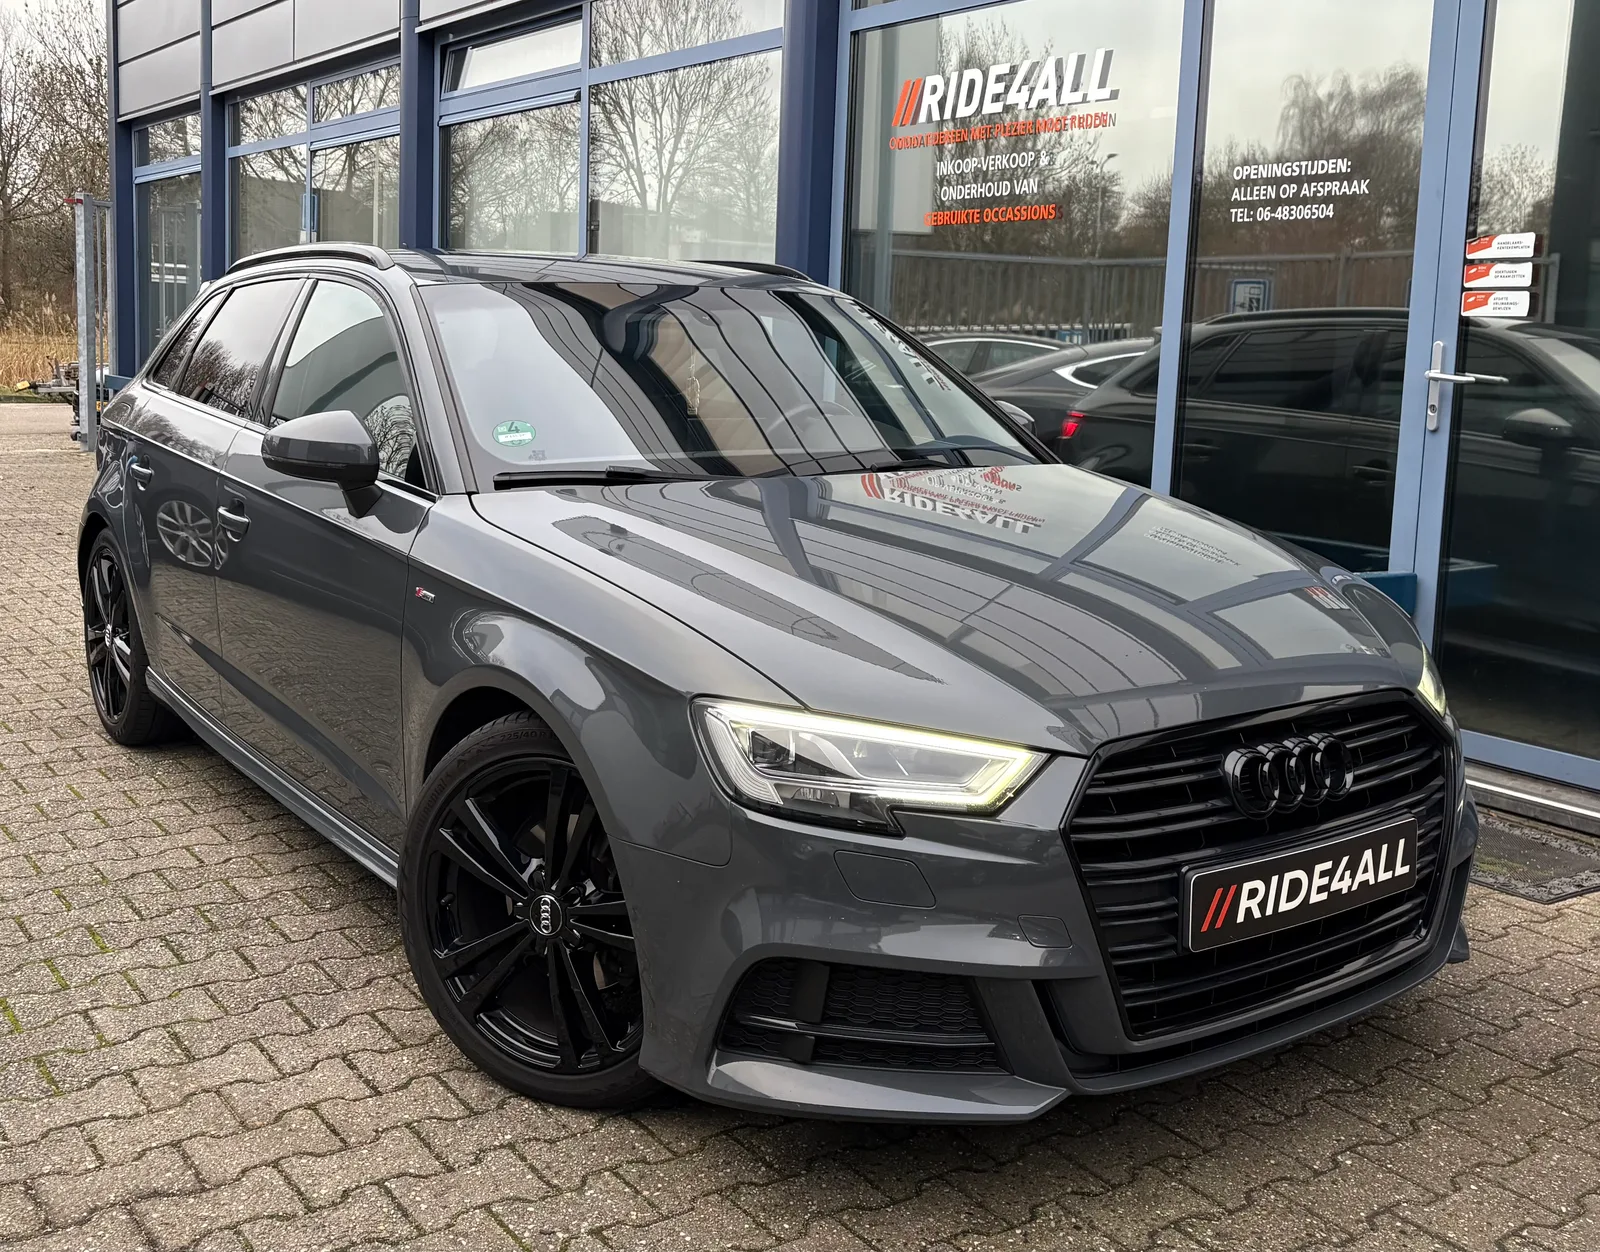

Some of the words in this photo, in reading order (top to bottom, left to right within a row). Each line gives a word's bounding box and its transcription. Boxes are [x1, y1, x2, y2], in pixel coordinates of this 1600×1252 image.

[970, 125, 993, 141] MET
[994, 121, 1034, 137] PLEZIER
[1035, 116, 1068, 133] MOET
[937, 151, 1035, 177] INKOOP-VERKOOP
[1040, 150, 1050, 166] &
[1233, 158, 1351, 180] OPENINGSTIJDEN:
[941, 180, 1011, 201] ONDERHOUD
[1014, 178, 1039, 195] VAN
[1231, 184, 1276, 201] ALLEEN
[1279, 184, 1298, 199] OP
[1300, 179, 1370, 198] AFSPRAAK
[923, 209, 980, 227] GEBRUIKTE
[983, 203, 1056, 222] OCCASSIONS
[1230, 208, 1253, 222] TEL:
[1256, 204, 1334, 221] 06-48306504
